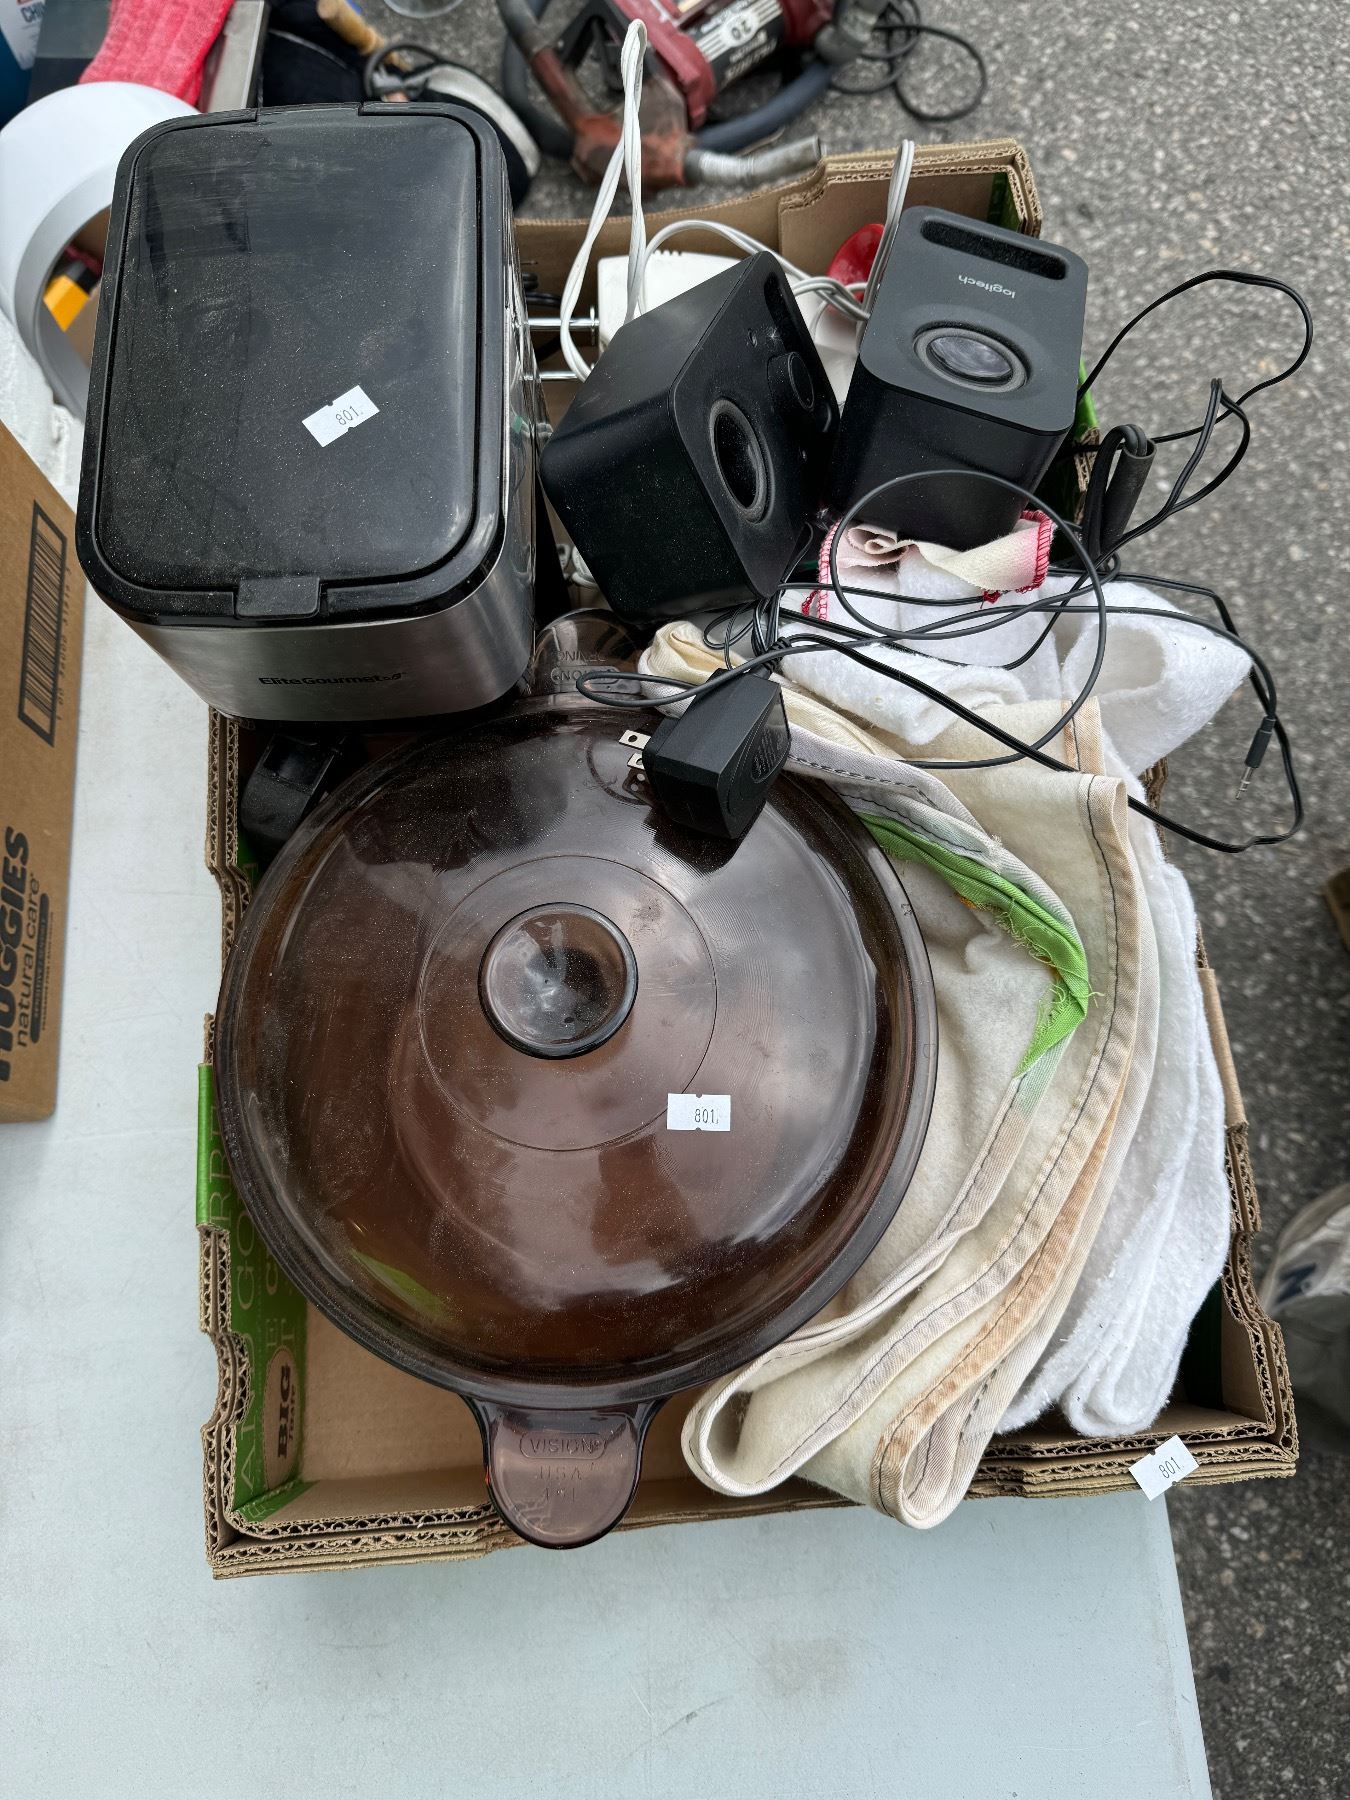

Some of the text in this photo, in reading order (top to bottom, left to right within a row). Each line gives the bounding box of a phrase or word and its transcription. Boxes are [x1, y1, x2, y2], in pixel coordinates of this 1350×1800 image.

[958, 275, 1016, 299] logitech
[17, 875, 39, 1047] natural care
[277, 1365, 290, 1458] BIG
